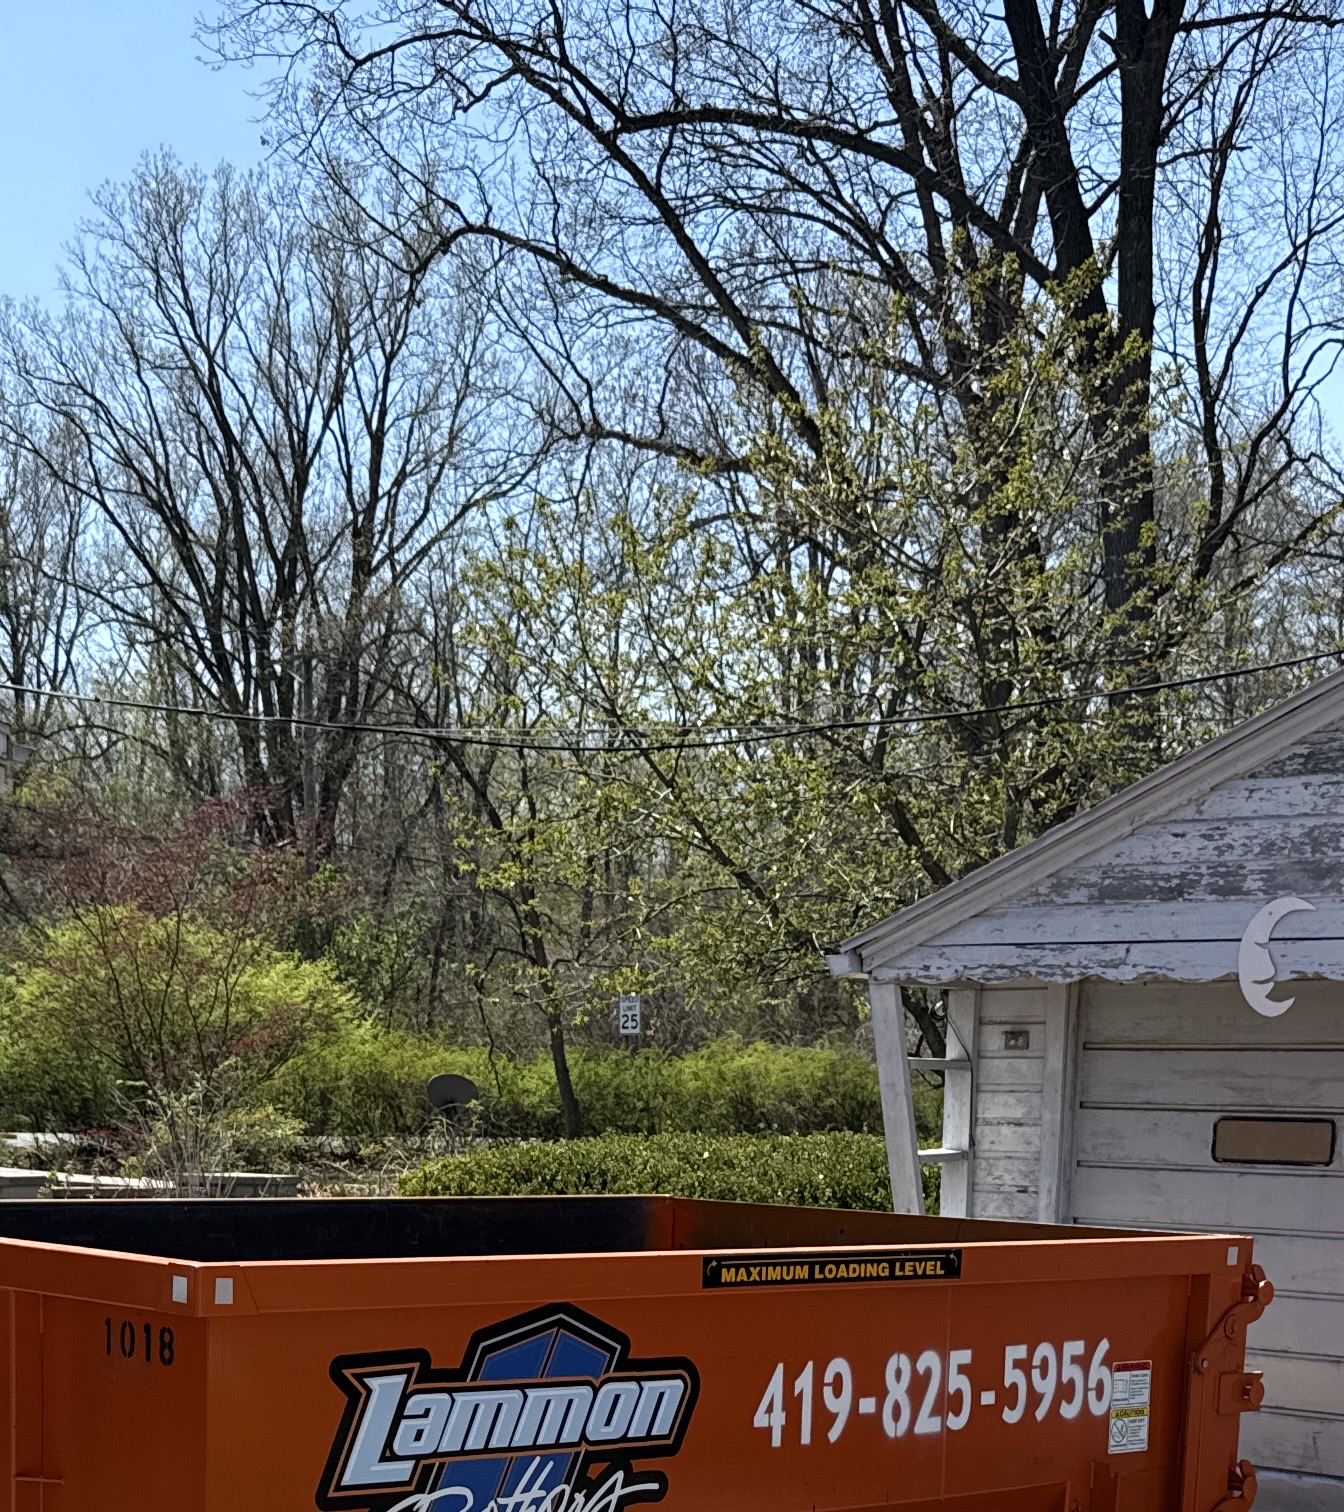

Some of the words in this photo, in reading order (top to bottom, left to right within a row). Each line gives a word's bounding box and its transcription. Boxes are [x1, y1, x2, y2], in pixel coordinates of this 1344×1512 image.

[622, 1014, 638, 1029] 25
[721, 1265, 809, 1283] MAXIMUM
[814, 1262, 890, 1279] LOADING
[894, 1260, 945, 1276] LEVEL
[105, 1317, 175, 1366] 1018
[753, 1337, 1112, 1447] 419-825-5956
[340, 1373, 685, 1487] Lammon
